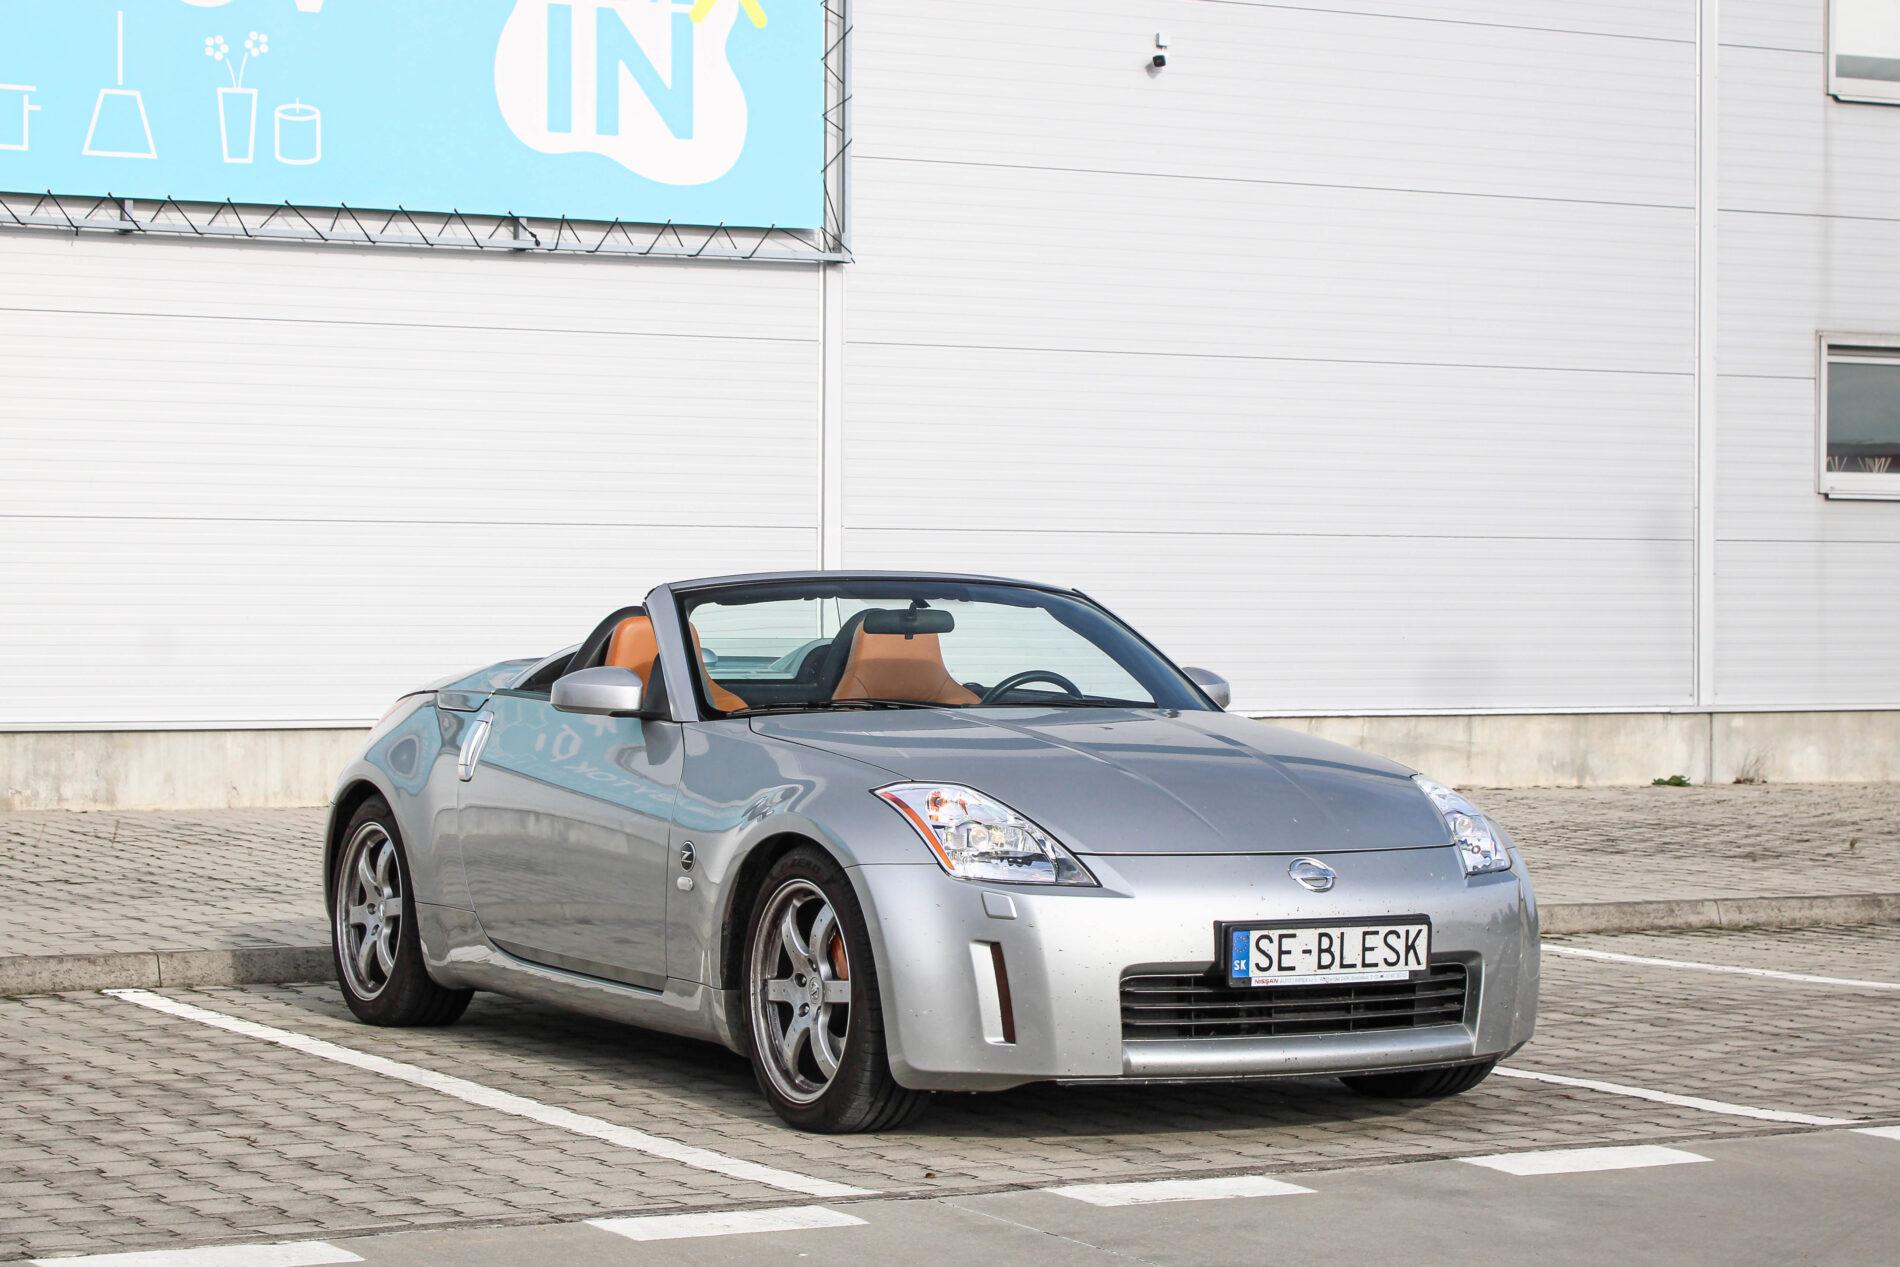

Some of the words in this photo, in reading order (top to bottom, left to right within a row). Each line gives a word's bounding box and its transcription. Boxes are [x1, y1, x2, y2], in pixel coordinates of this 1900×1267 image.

[547, 3, 693, 139] IN
[1254, 929, 1423, 972] SE-BLESK
[1234, 959, 1247, 971] SK
[1254, 977, 1279, 985] NISSAN
